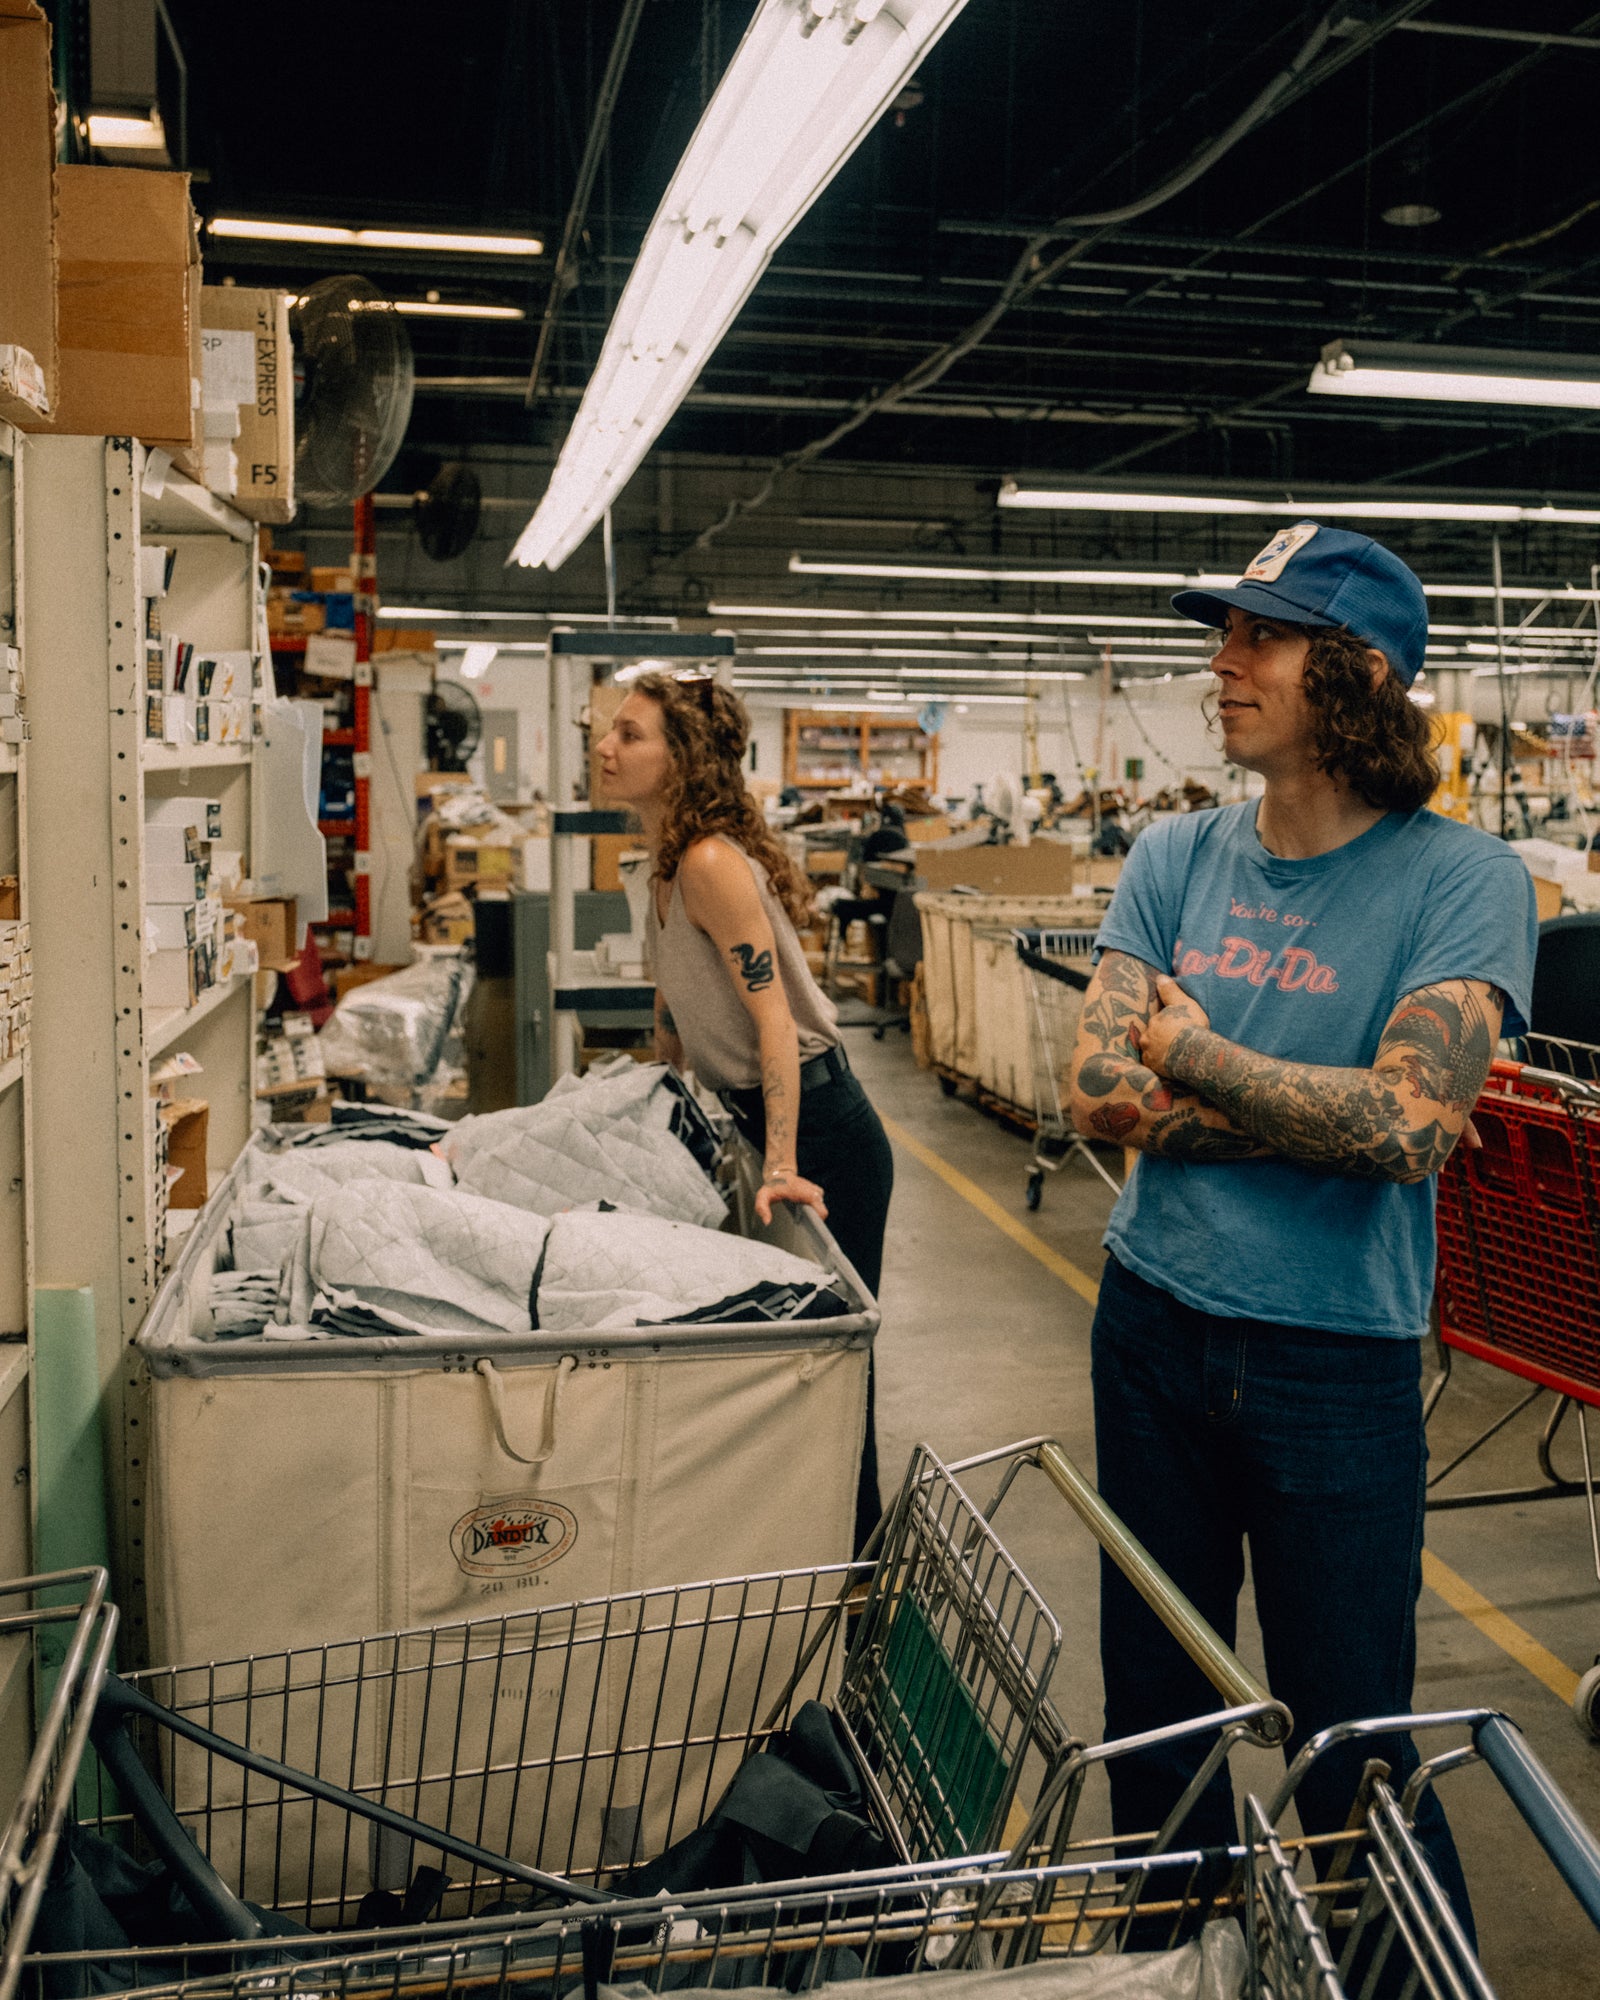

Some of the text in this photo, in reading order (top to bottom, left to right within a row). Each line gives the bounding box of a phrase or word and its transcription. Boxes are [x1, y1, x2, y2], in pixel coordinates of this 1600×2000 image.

[257, 338, 277, 416] EXPRESS
[251, 464, 278, 485] F5
[1229, 897, 1278, 922] You're
[471, 1519, 549, 1555] DANDUX
